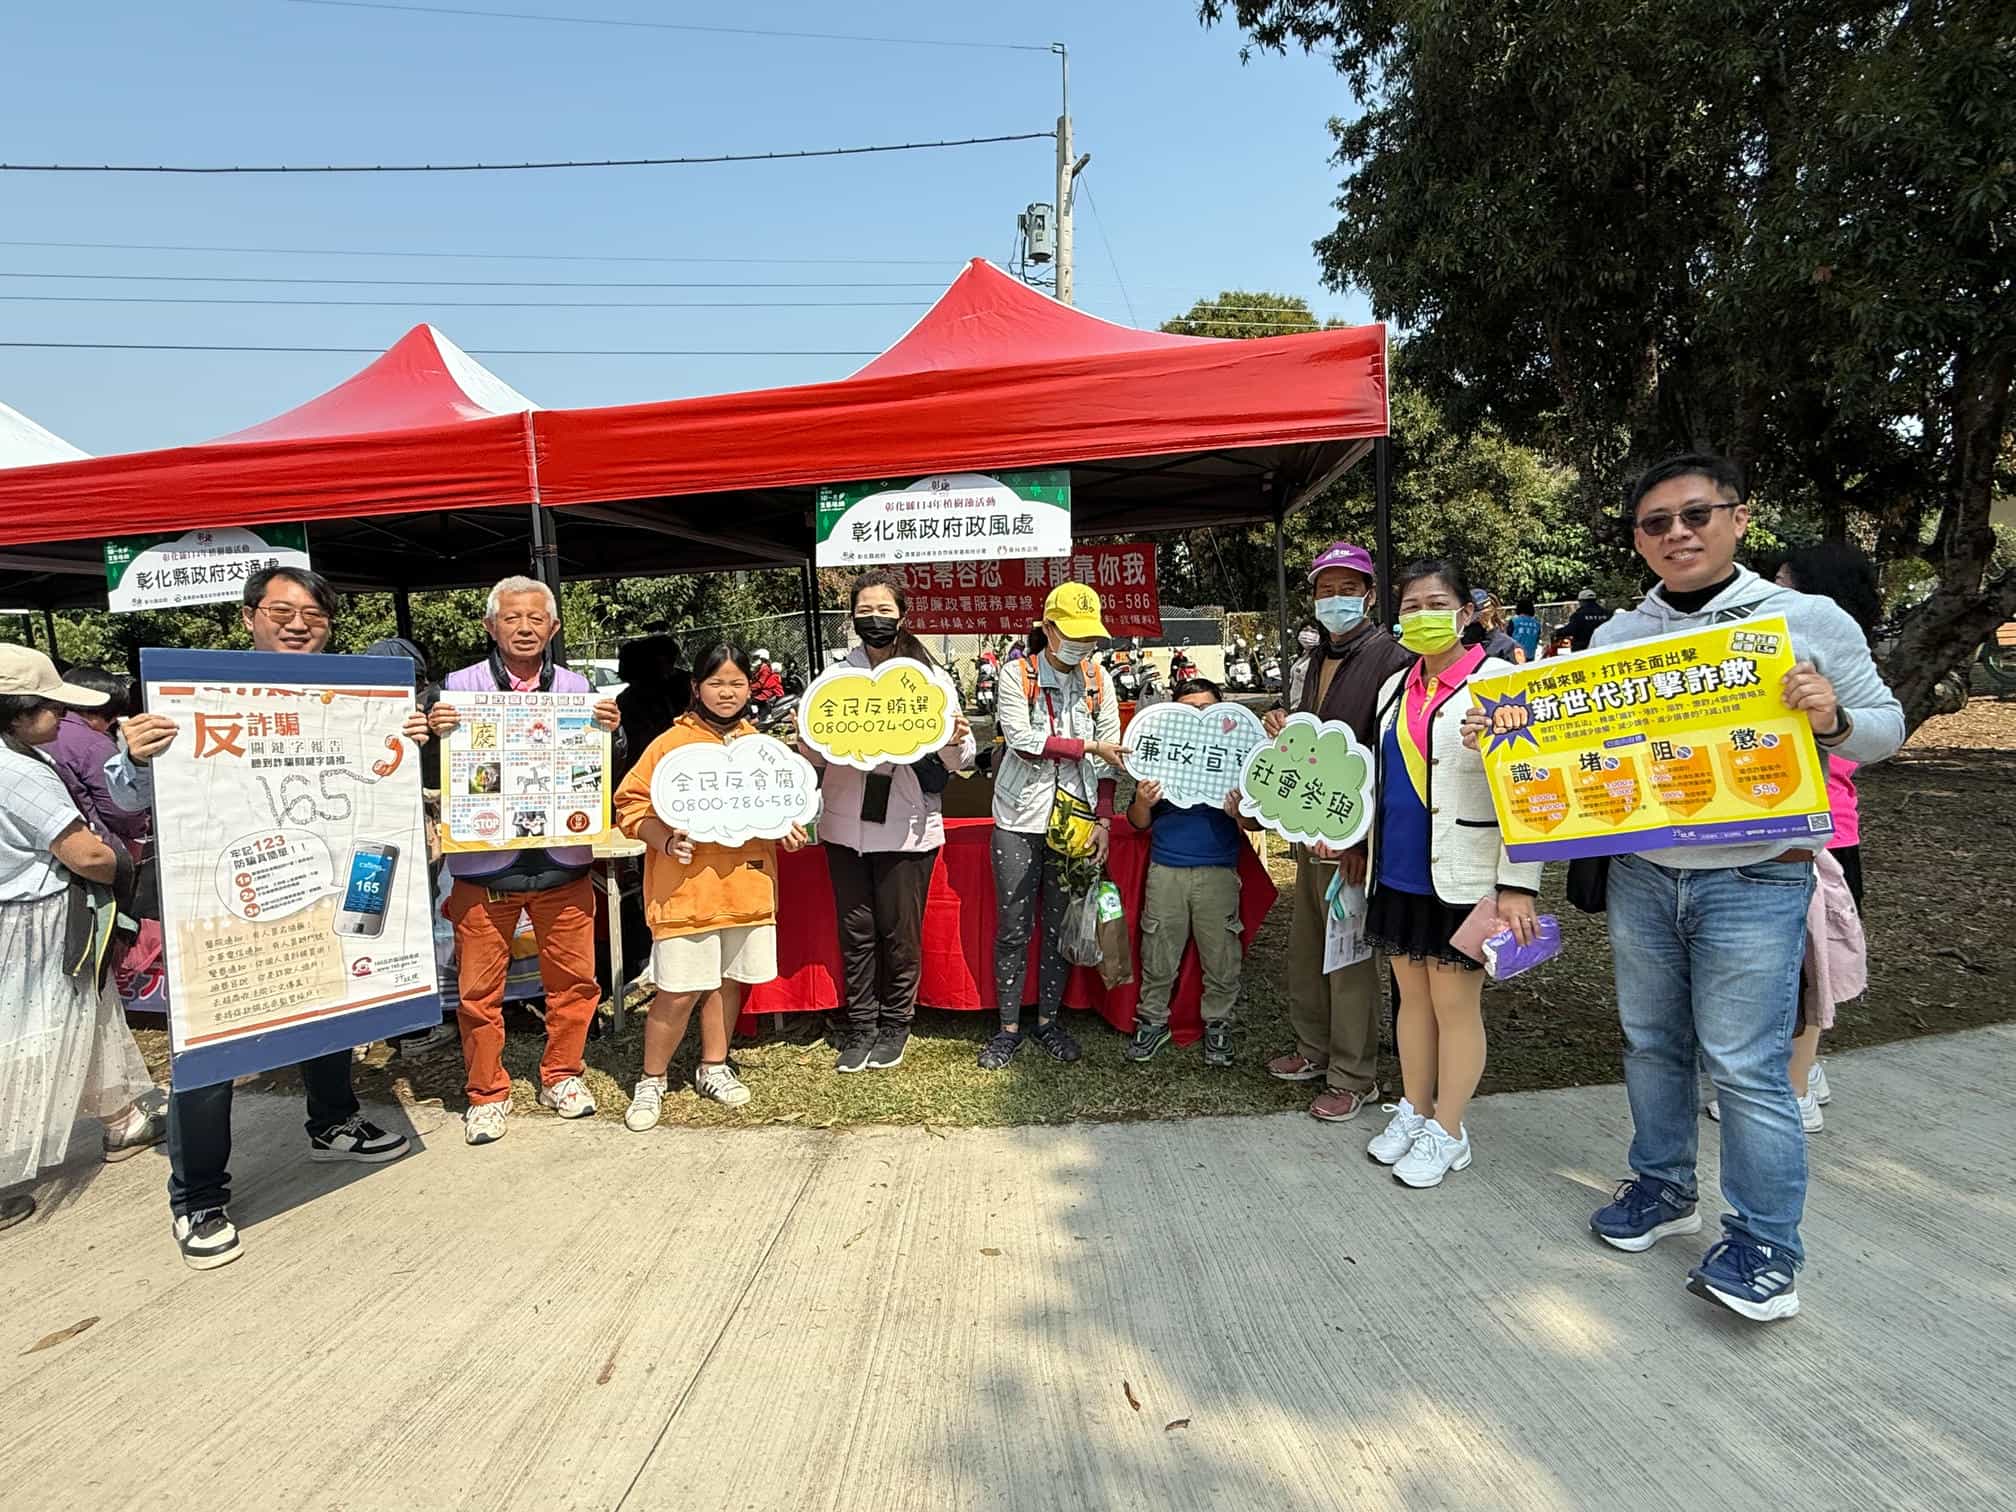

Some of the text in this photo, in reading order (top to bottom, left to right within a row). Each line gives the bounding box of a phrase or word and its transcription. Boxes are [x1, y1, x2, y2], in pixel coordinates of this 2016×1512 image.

[852, 513, 1034, 543] 彰化縣政府政風處
[1527, 648, 1699, 694] 詐騙來襲，打詐全面出擊
[1531, 657, 1762, 723] 新世代打擊詐欺
[819, 696, 929, 718] 全民反賄選
[812, 718, 937, 735] 0800-024-099
[1651, 740, 1676, 761] 阻
[1730, 728, 1759, 751] 懲
[1511, 763, 1533, 784] 識
[1579, 752, 1602, 773] 堵
[671, 768, 795, 793] 全民反貪腐
[1251, 758, 1355, 824] 社會參與
[672, 792, 806, 813] 0800-286-586
[356, 880, 380, 893] 165
